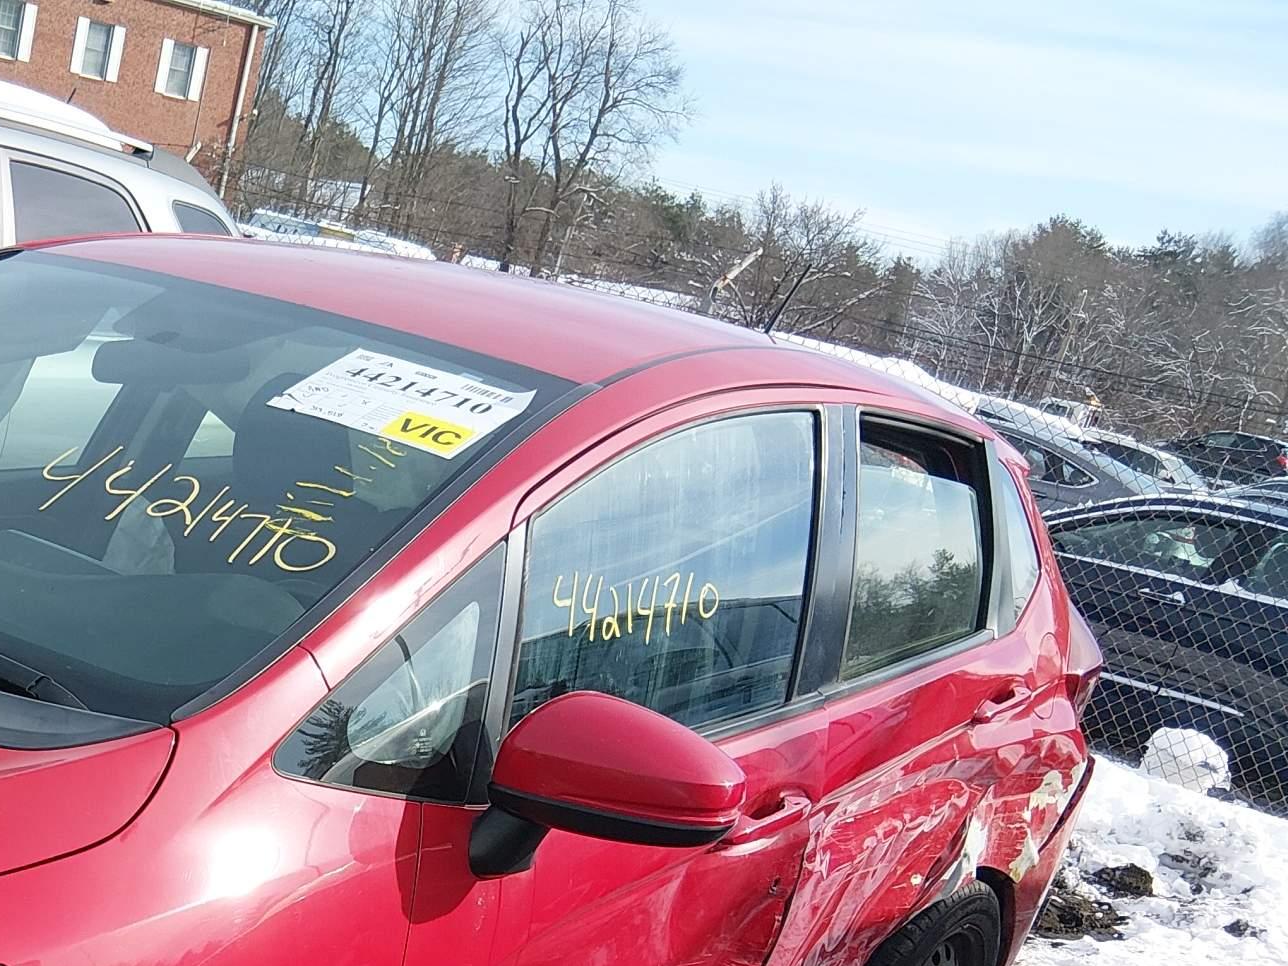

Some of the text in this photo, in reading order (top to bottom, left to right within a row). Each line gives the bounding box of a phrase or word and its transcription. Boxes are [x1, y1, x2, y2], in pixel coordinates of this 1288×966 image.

[345, 366, 493, 416] 44214710
[399, 416, 462, 447] VIC
[553, 571, 720, 646] 44214710
